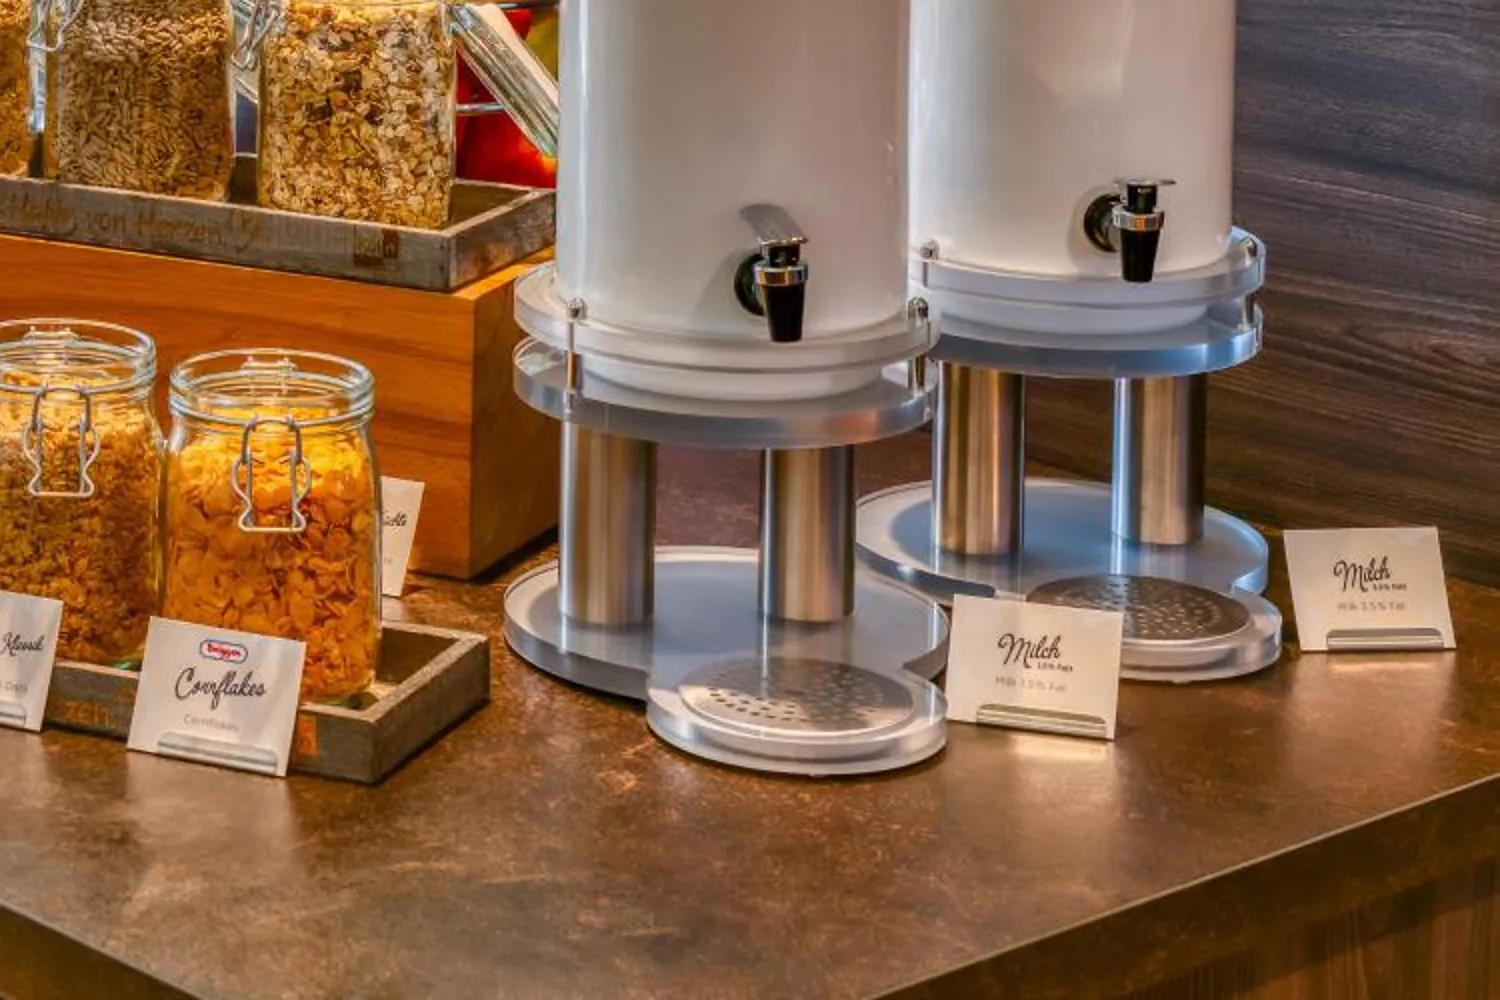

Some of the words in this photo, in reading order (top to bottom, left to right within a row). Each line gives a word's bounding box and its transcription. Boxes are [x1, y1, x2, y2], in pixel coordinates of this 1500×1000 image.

[1333, 556, 1391, 592] Milch
[997, 633, 1062, 669] Milch
[174, 666, 267, 710] Cornflakes
